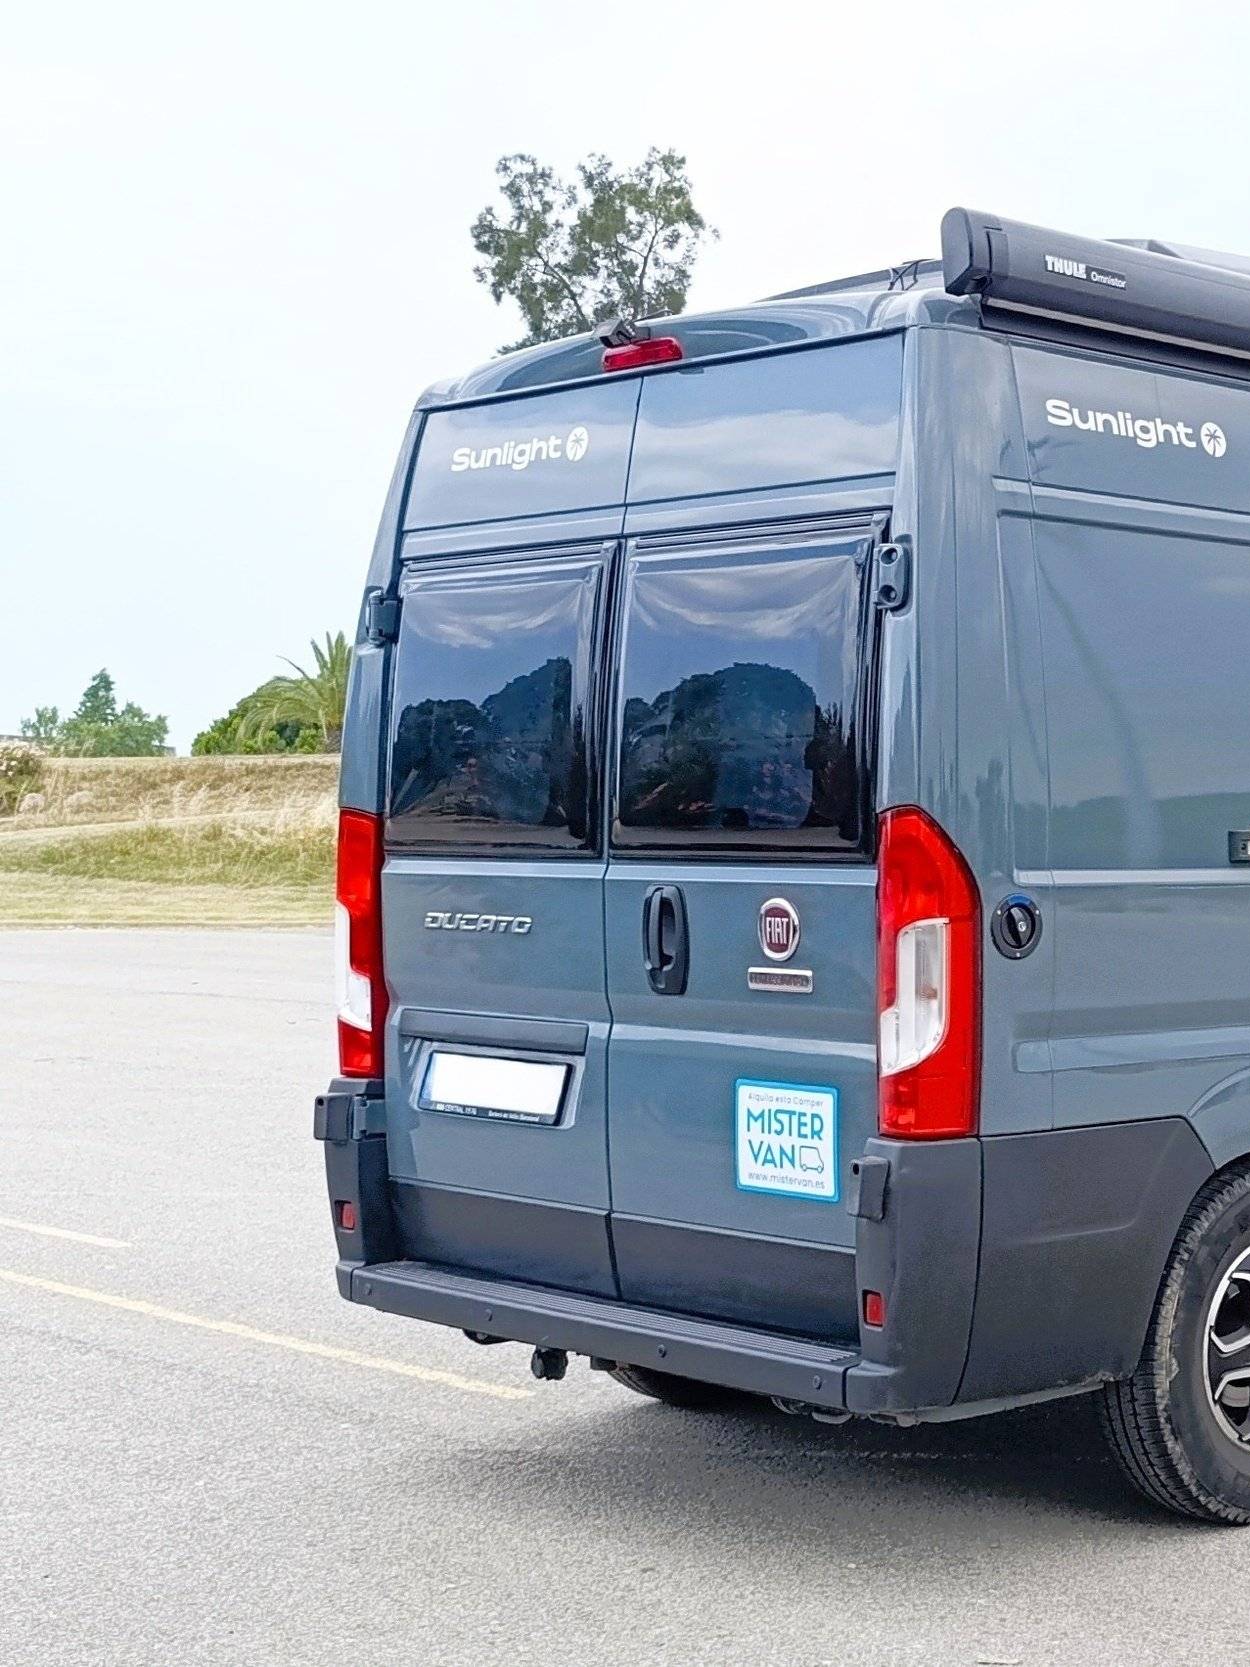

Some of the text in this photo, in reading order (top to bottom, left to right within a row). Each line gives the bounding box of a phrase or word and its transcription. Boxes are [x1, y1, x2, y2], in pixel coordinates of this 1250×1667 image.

[1045, 255, 1087, 279] THULE
[1046, 399, 1197, 448] Sunlight
[451, 435, 562, 471] Sunlight
[424, 912, 532, 933] DUCATO
[766, 917, 789, 944] FIAT
[747, 1107, 824, 1140] MISTER
[748, 1139, 796, 1169] VAN
[748, 1172, 826, 1189] www.mistervan.es
